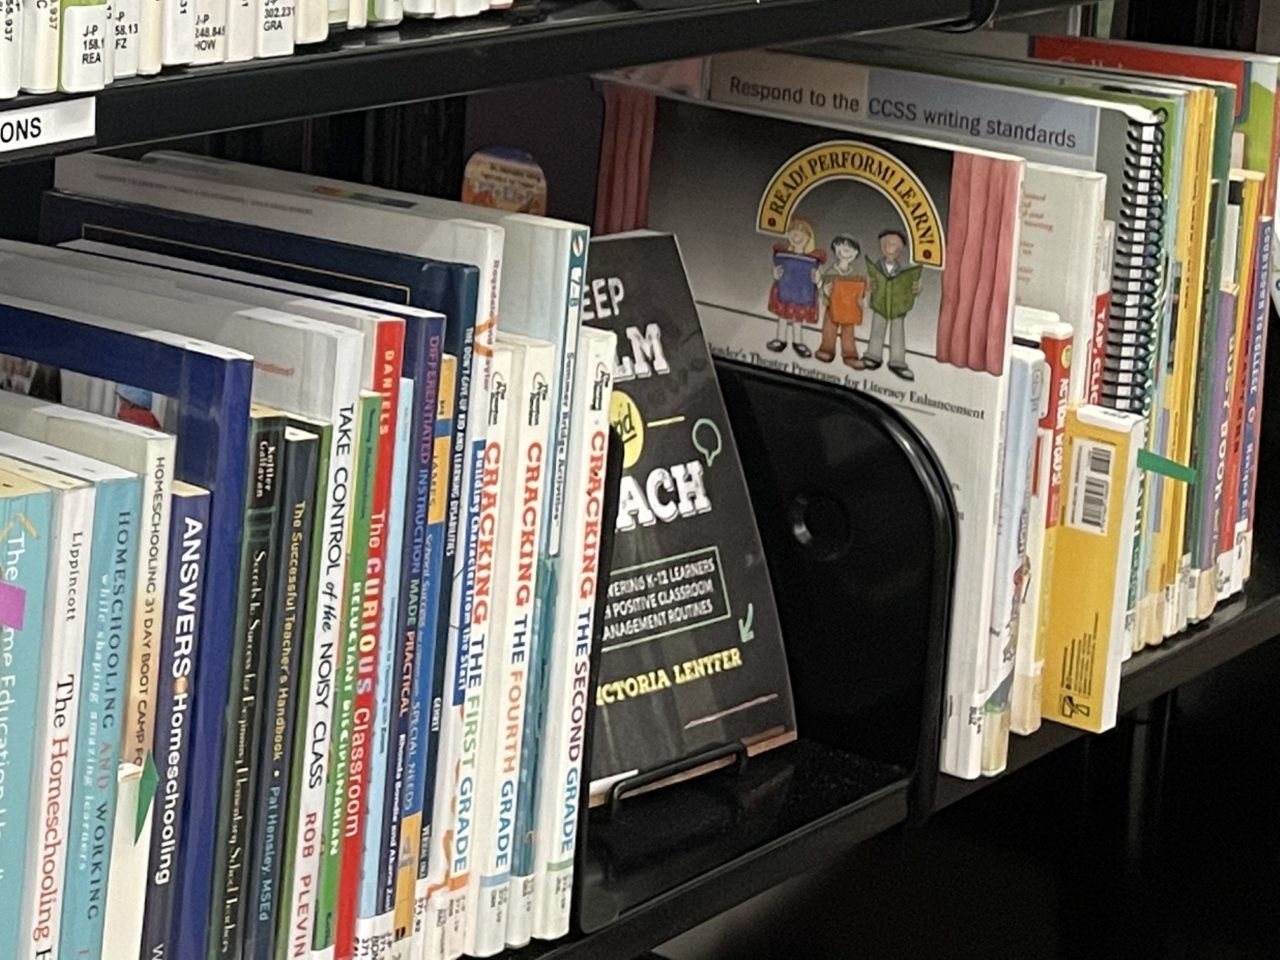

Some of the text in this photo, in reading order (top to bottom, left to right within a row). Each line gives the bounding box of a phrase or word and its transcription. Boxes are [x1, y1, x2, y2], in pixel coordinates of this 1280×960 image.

[729, 75, 1078, 150] Respond to the CCSS writing standards
[768, 144, 937, 247] READ! PERFORM! LEARN!
[335, 404, 354, 456] TAKE
[378, 350, 395, 436] DANIELS
[325, 467, 348, 576] CONTROL
[578, 430, 606, 599] CRACKING
[65, 530, 84, 622] Lippincott
[172, 516, 203, 679] ANSWERS
[325, 582, 338, 602] of
[312, 641, 334, 711] NOISY
[576, 606, 592, 658] THE
[344, 556, 384, 838] CURIOUS Classroom
[568, 659, 590, 762] SECOND
[154, 693, 188, 887] Homeschooling
[308, 720, 328, 789] CLASS
[32, 673, 75, 942] The Homeschooling
[560, 766, 579, 854] GRADE
